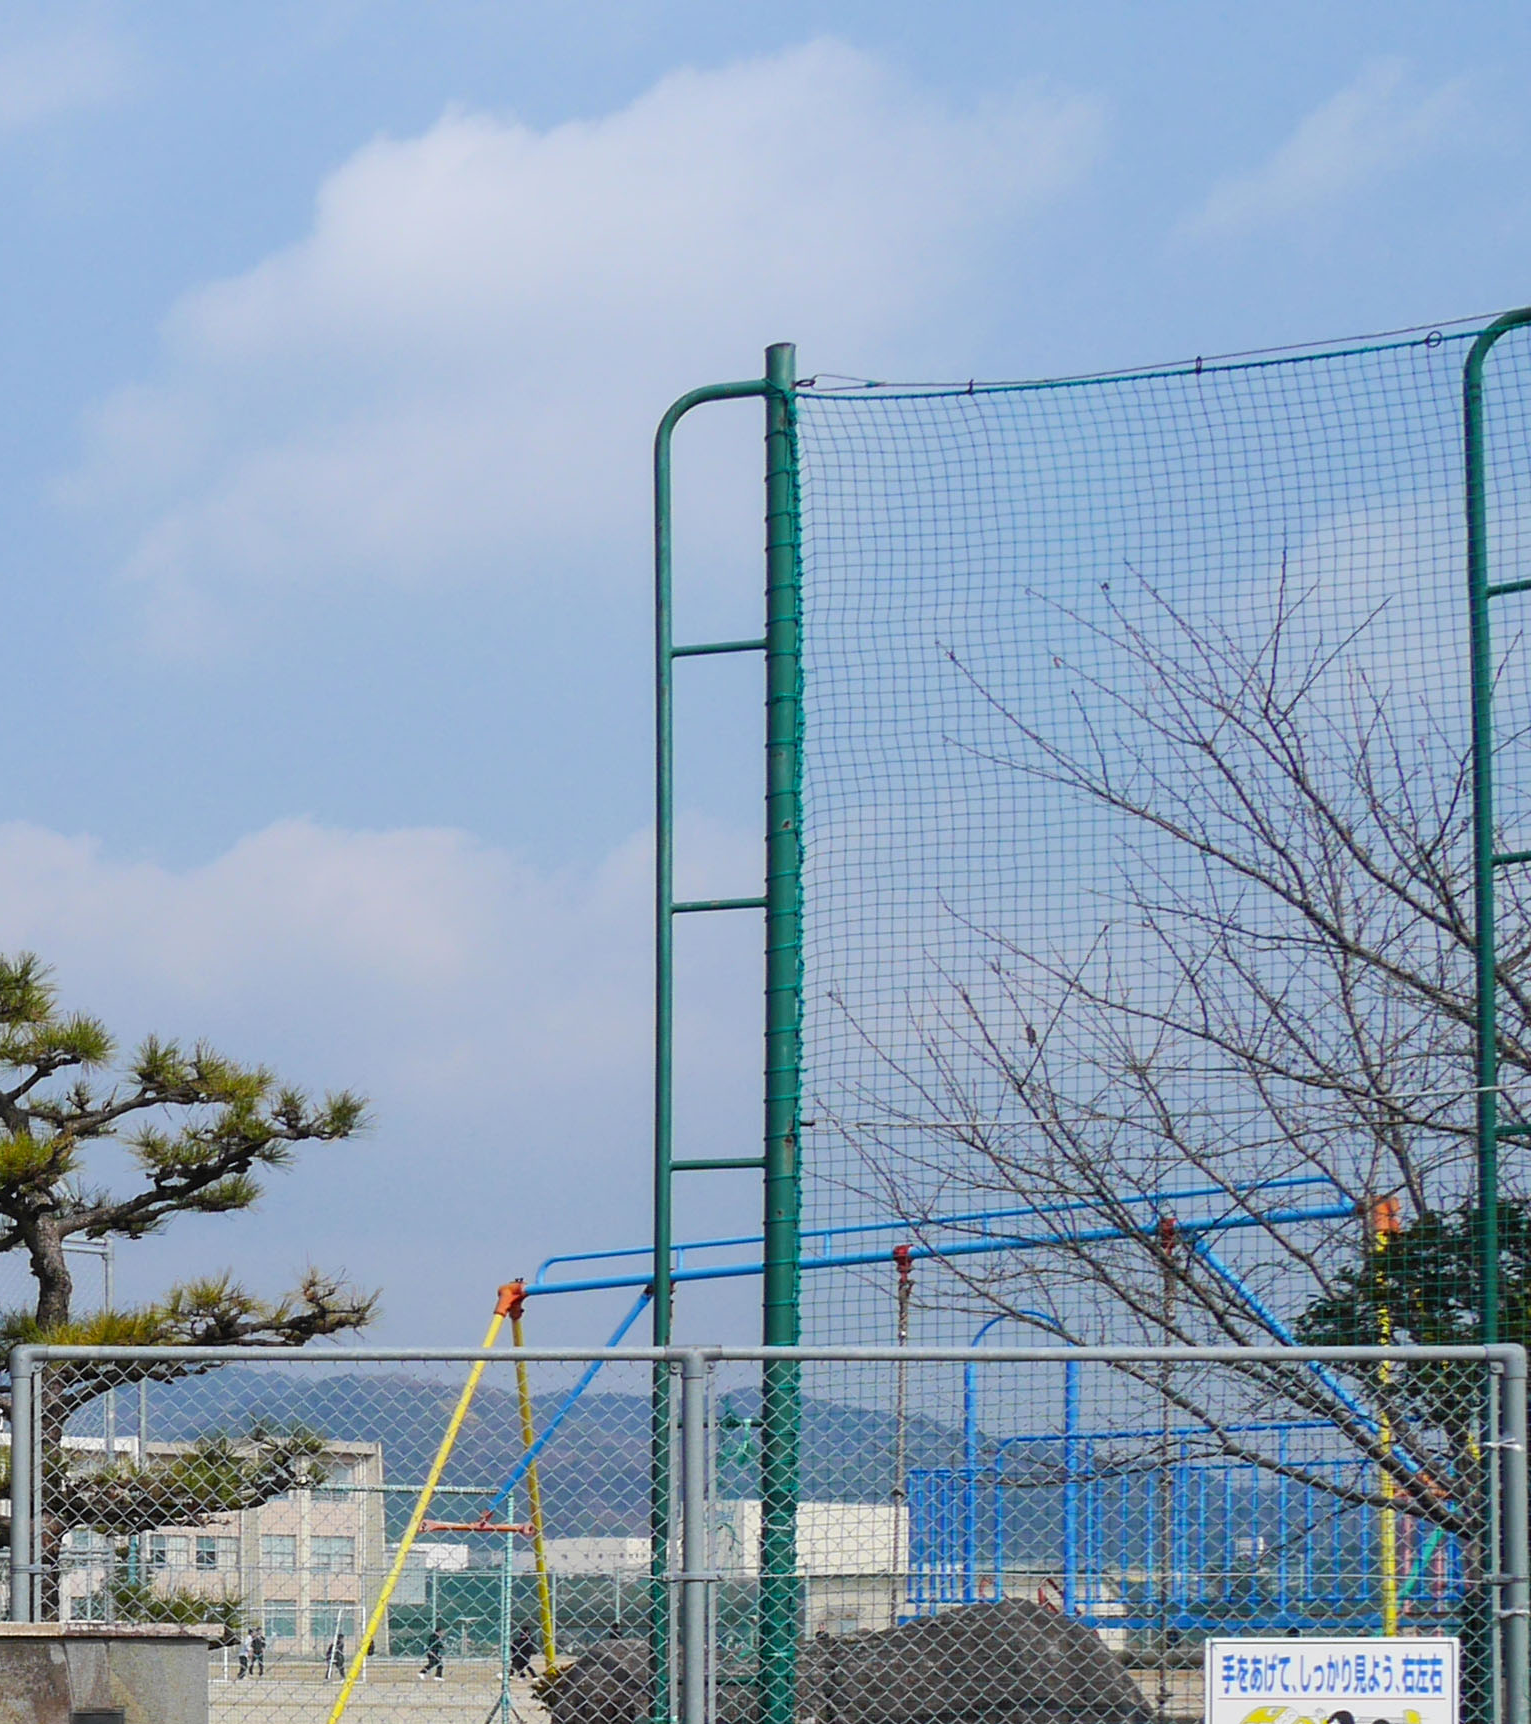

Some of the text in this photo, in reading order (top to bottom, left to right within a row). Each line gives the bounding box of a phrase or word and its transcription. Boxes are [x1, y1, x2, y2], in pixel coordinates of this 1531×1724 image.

[1221, 1653, 1443, 1694] 手をあげて、しっかり見よう、右左右
